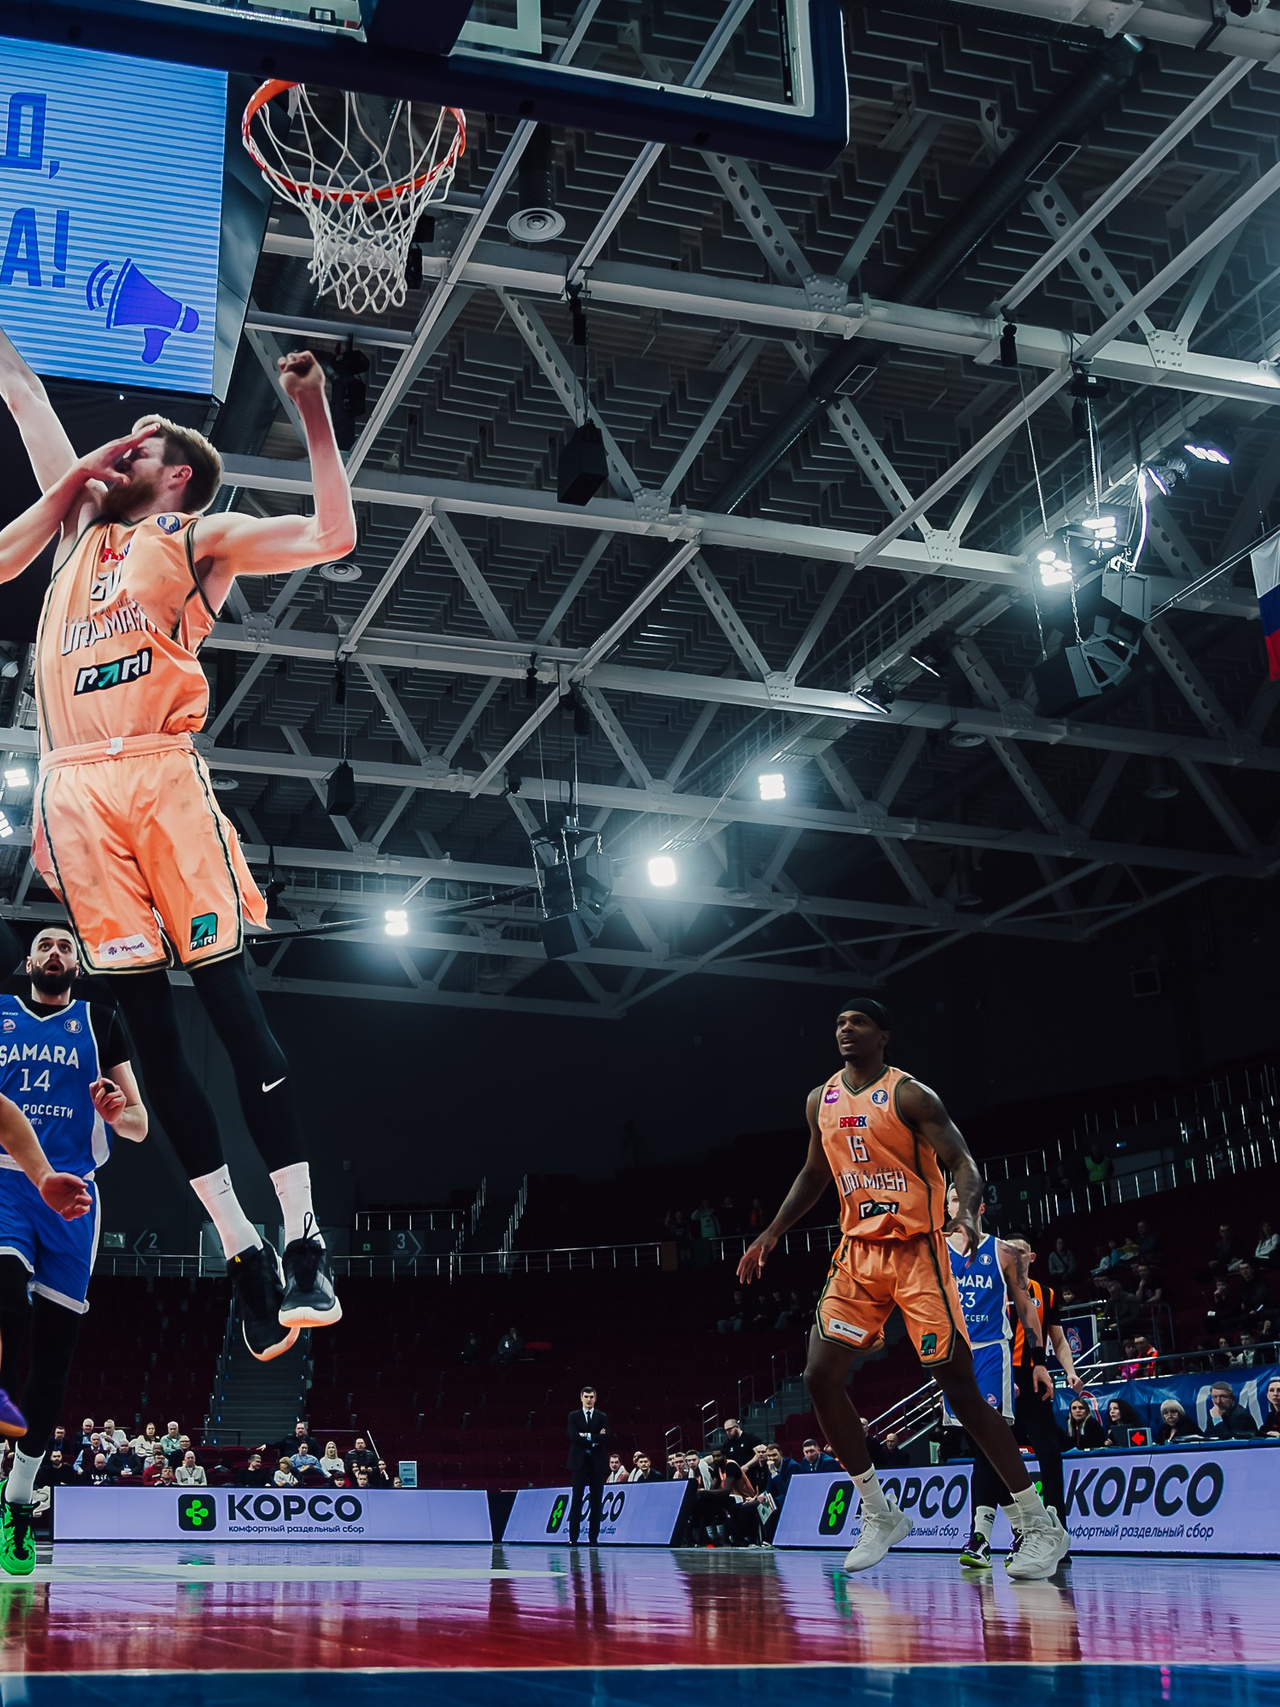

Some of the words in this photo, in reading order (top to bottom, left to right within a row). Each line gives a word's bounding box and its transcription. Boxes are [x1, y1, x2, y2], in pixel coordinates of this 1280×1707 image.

[20, 1068, 51, 1092] 14
[22, 1104, 74, 1119] РОССЕТИ
[846, 1135, 870, 1163] 15
[148, 1232, 158, 1249] 2
[396, 1233, 406, 1249] 3
[955, 1274, 992, 1289] MARA
[965, 1314, 989, 1323] ССЕТИ
[1066, 1462, 1225, 1517] КОРСО
[227, 1494, 363, 1522] КОРСО
[228, 1525, 285, 1533] комфортный
[287, 1525, 341, 1534] раздельный
[342, 1525, 365, 1534] сбор
[908, 1525, 938, 1537] ельный
[939, 1523, 959, 1539] сбор
[1069, 1524, 1120, 1539] мфортный
[1120, 1524, 1184, 1539] раздельный
[1186, 1523, 1214, 1541] сбор
